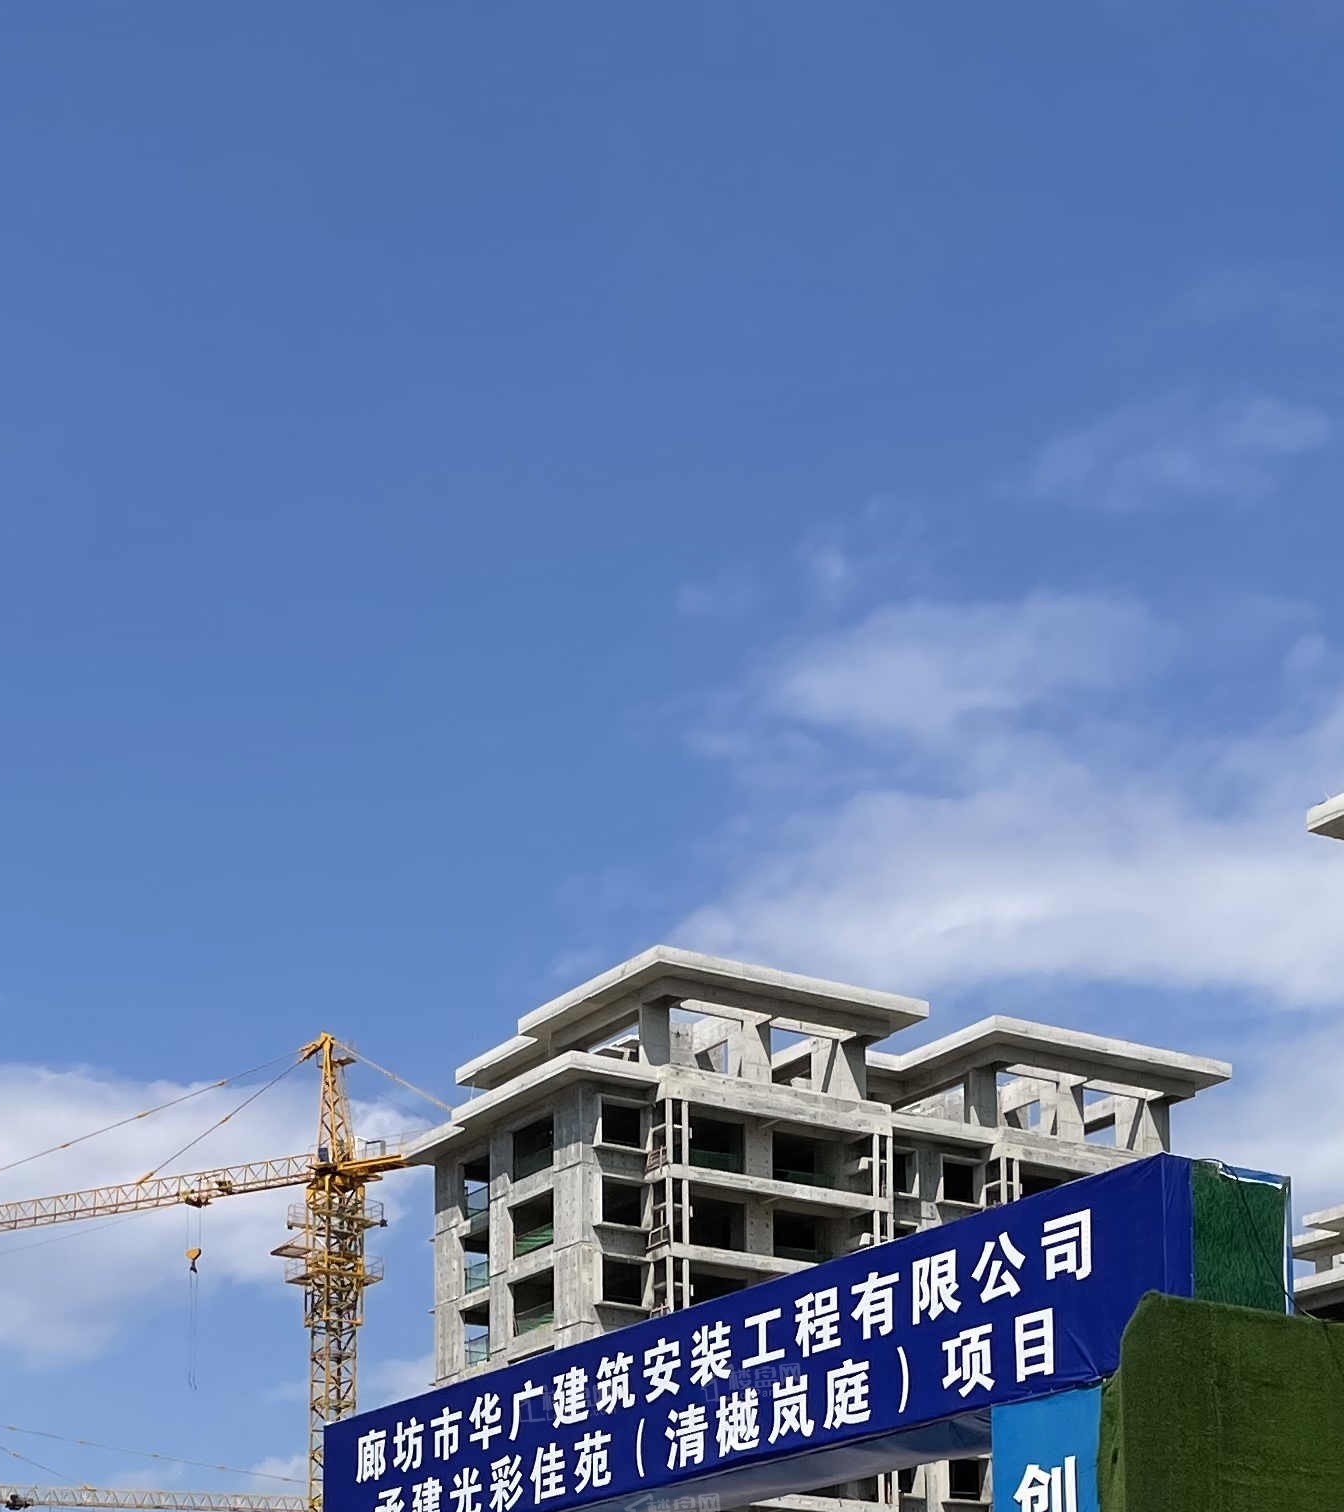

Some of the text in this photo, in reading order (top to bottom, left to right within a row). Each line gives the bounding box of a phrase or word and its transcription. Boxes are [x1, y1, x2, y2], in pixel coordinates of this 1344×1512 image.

[355, 1208, 1093, 1484] 廊坊市华广建筑安装工程有限公司
